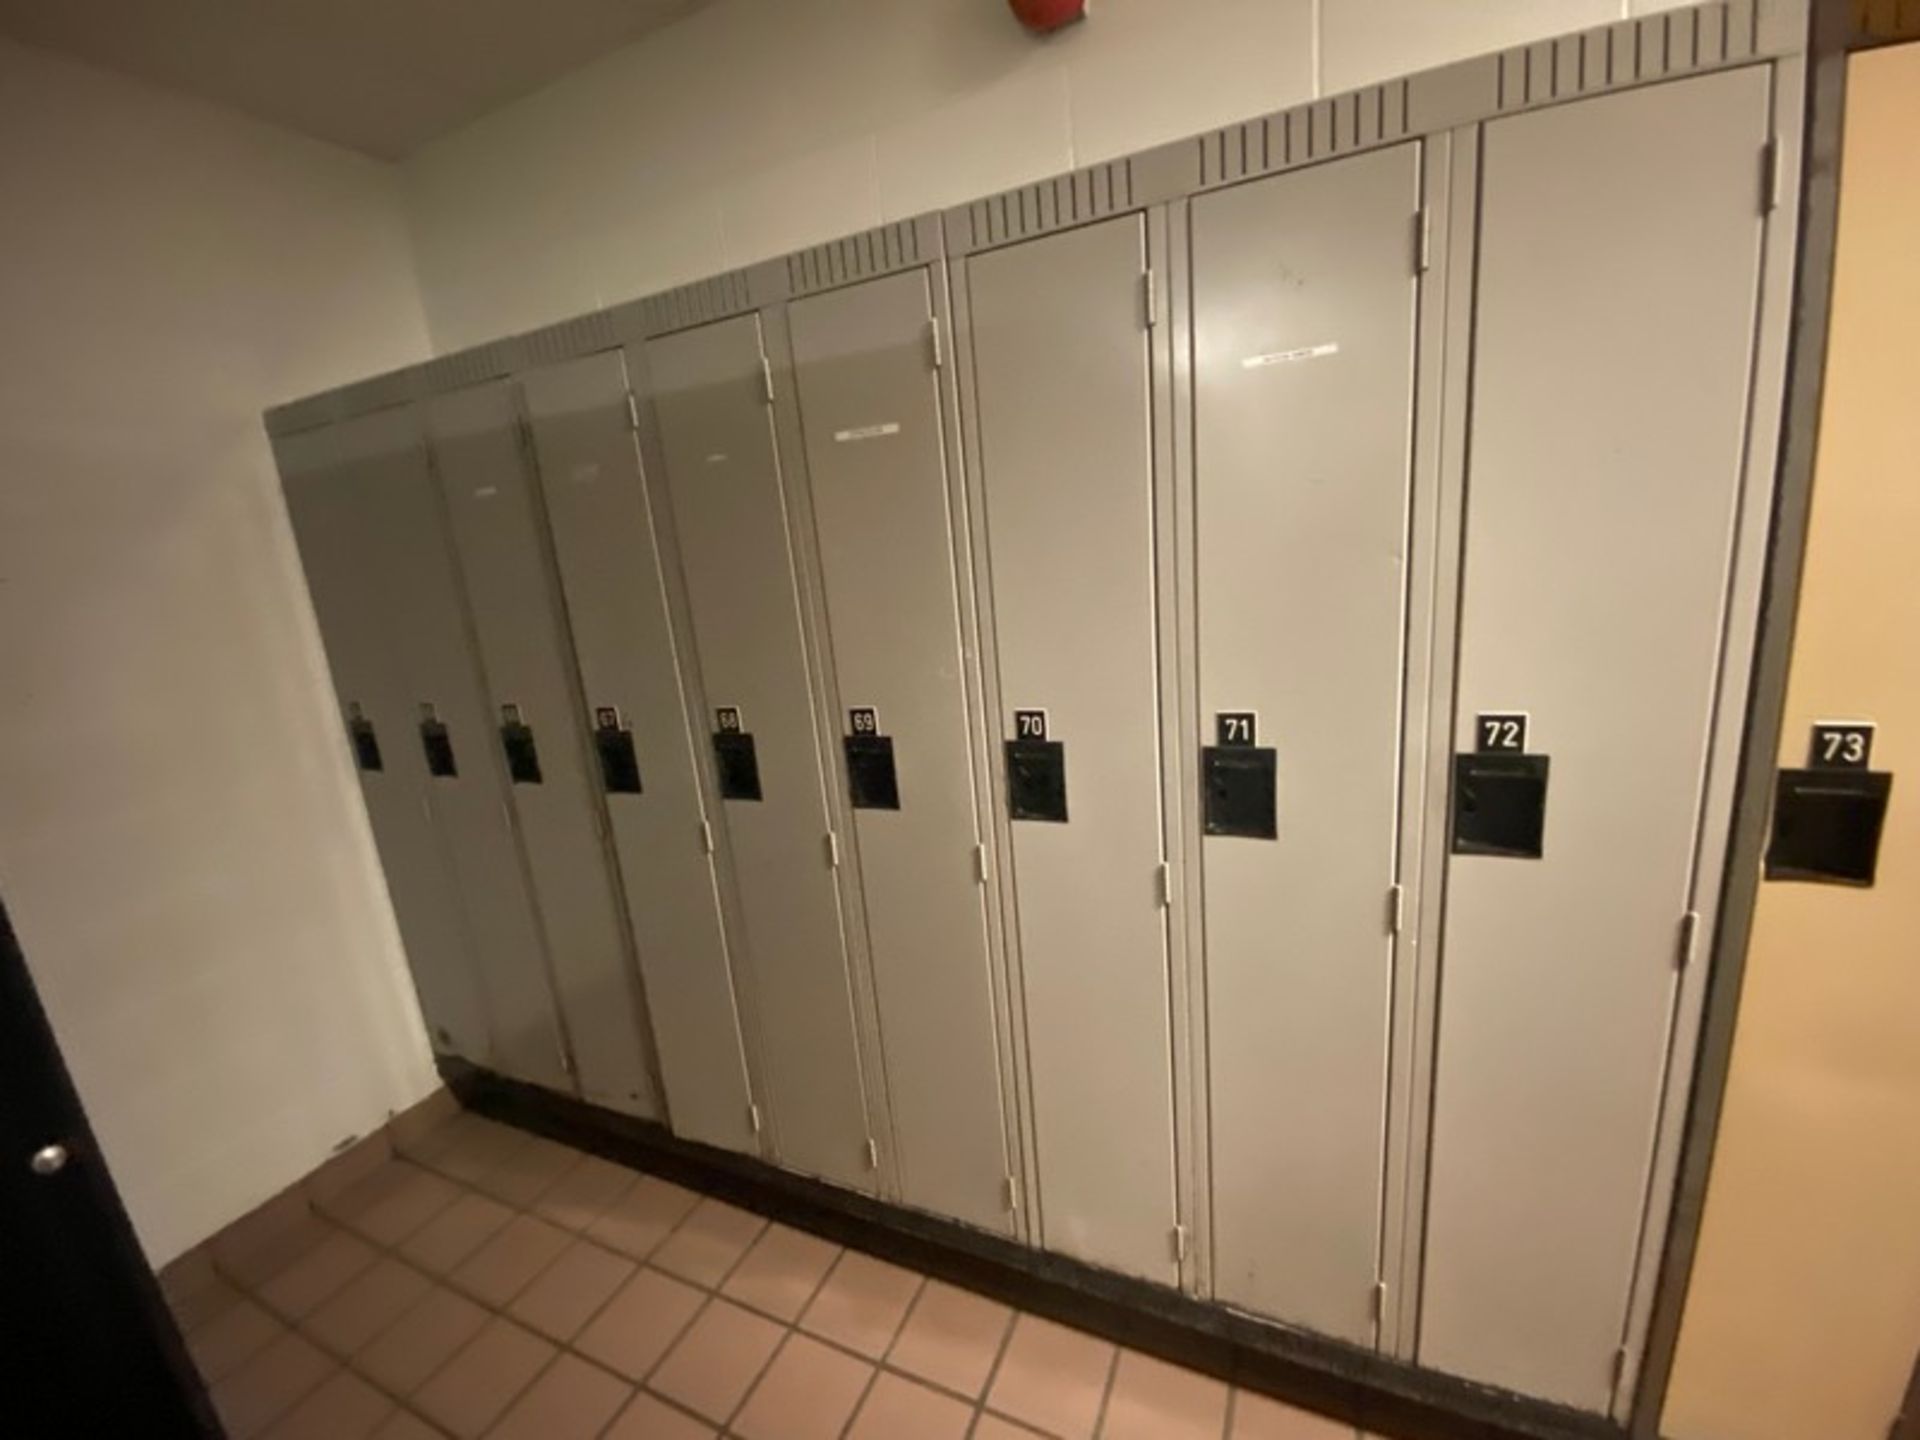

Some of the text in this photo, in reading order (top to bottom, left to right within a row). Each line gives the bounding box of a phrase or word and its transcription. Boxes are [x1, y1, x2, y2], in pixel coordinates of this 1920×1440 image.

[854, 712, 874, 731] 69
[1019, 715, 1043, 736] 70
[1224, 718, 1249, 741] 71
[1484, 721, 1520, 747] 72
[1822, 732, 1865, 762] 73
